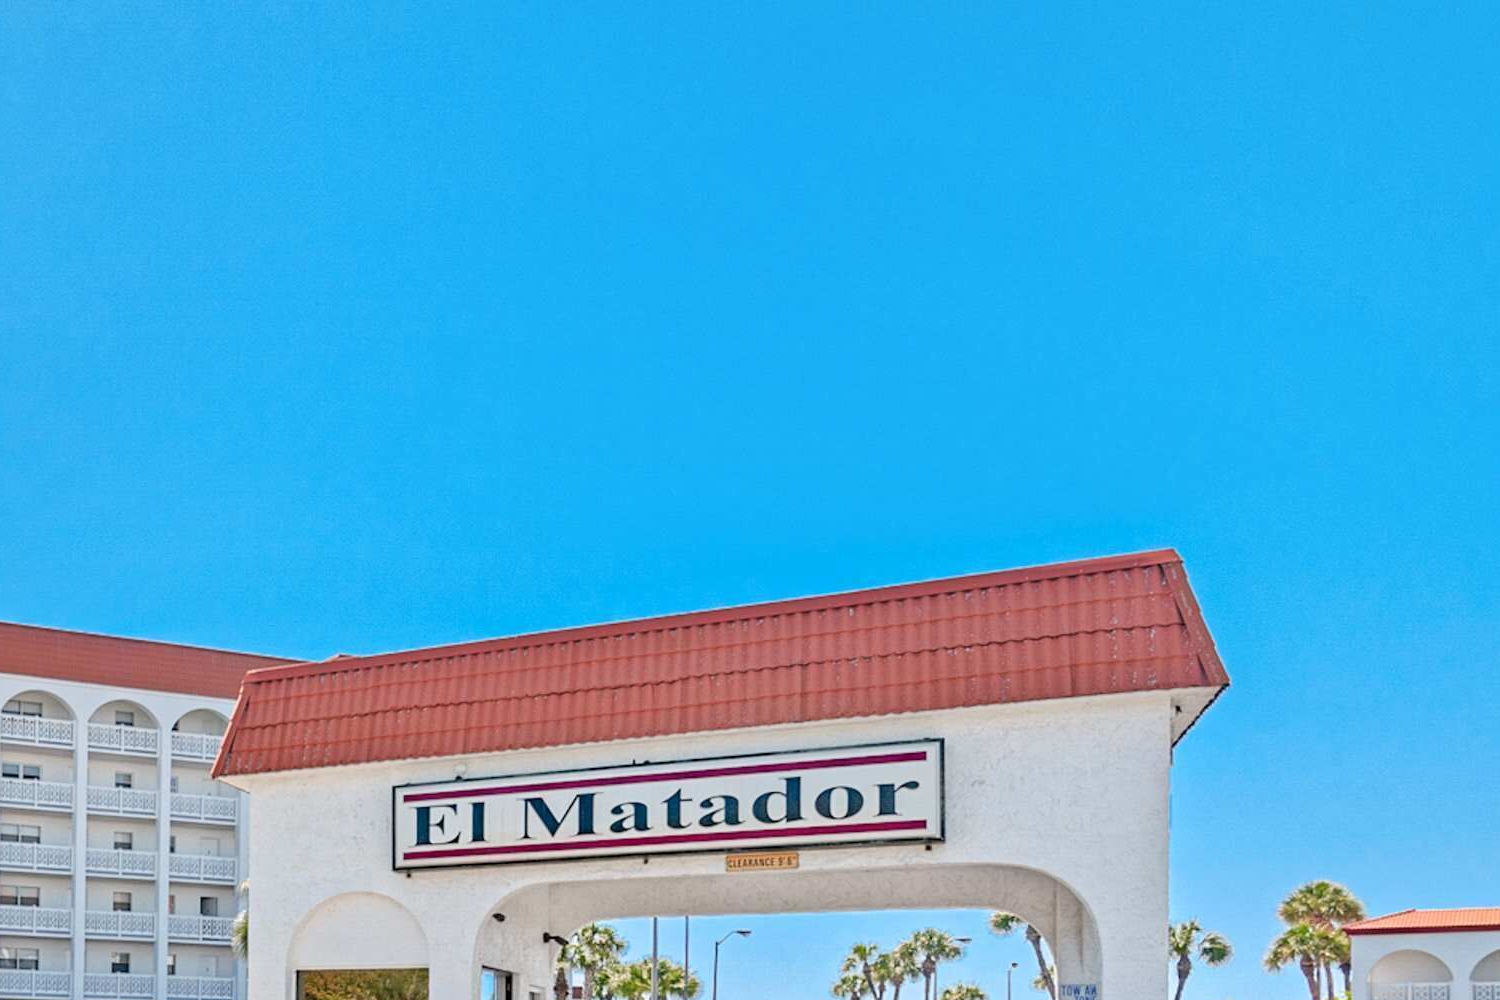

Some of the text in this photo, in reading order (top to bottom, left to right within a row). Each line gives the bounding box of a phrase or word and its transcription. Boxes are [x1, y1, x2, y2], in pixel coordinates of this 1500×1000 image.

[411, 775, 920, 847] El Matador
[728, 857, 775, 868] CLEARANCE
[1062, 984, 1080, 996] TOW
